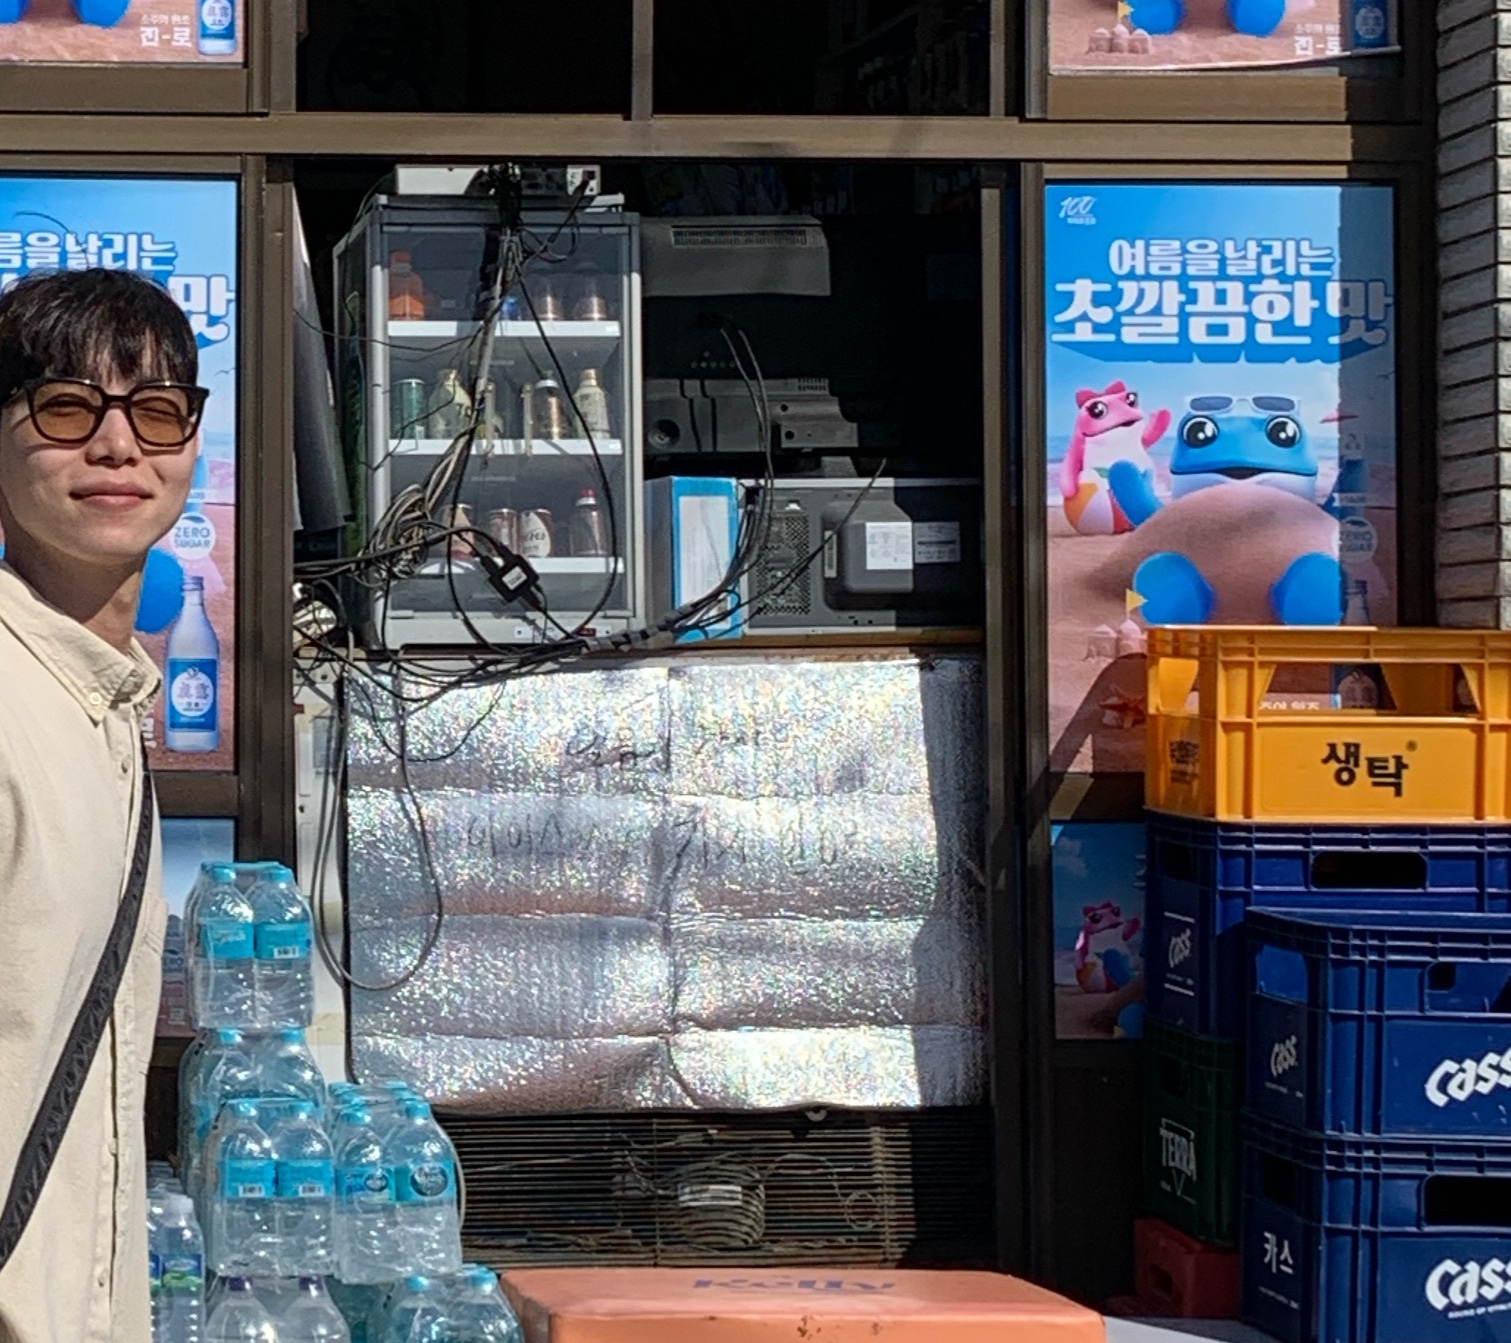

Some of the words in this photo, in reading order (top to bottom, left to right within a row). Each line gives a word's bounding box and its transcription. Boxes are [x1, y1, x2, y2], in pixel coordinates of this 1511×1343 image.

[1059, 197, 1097, 218] 100
[1051, 278, 1320, 345] 초깔끔한
[1326, 281, 1393, 345] 맛
[175, 526, 211, 539] ZERO
[175, 539, 211, 549] SUGAR
[1322, 741, 1409, 798] 생탁
[1159, 1127, 1198, 1182] TERRA
[1263, 1231, 1295, 1275] 카스
